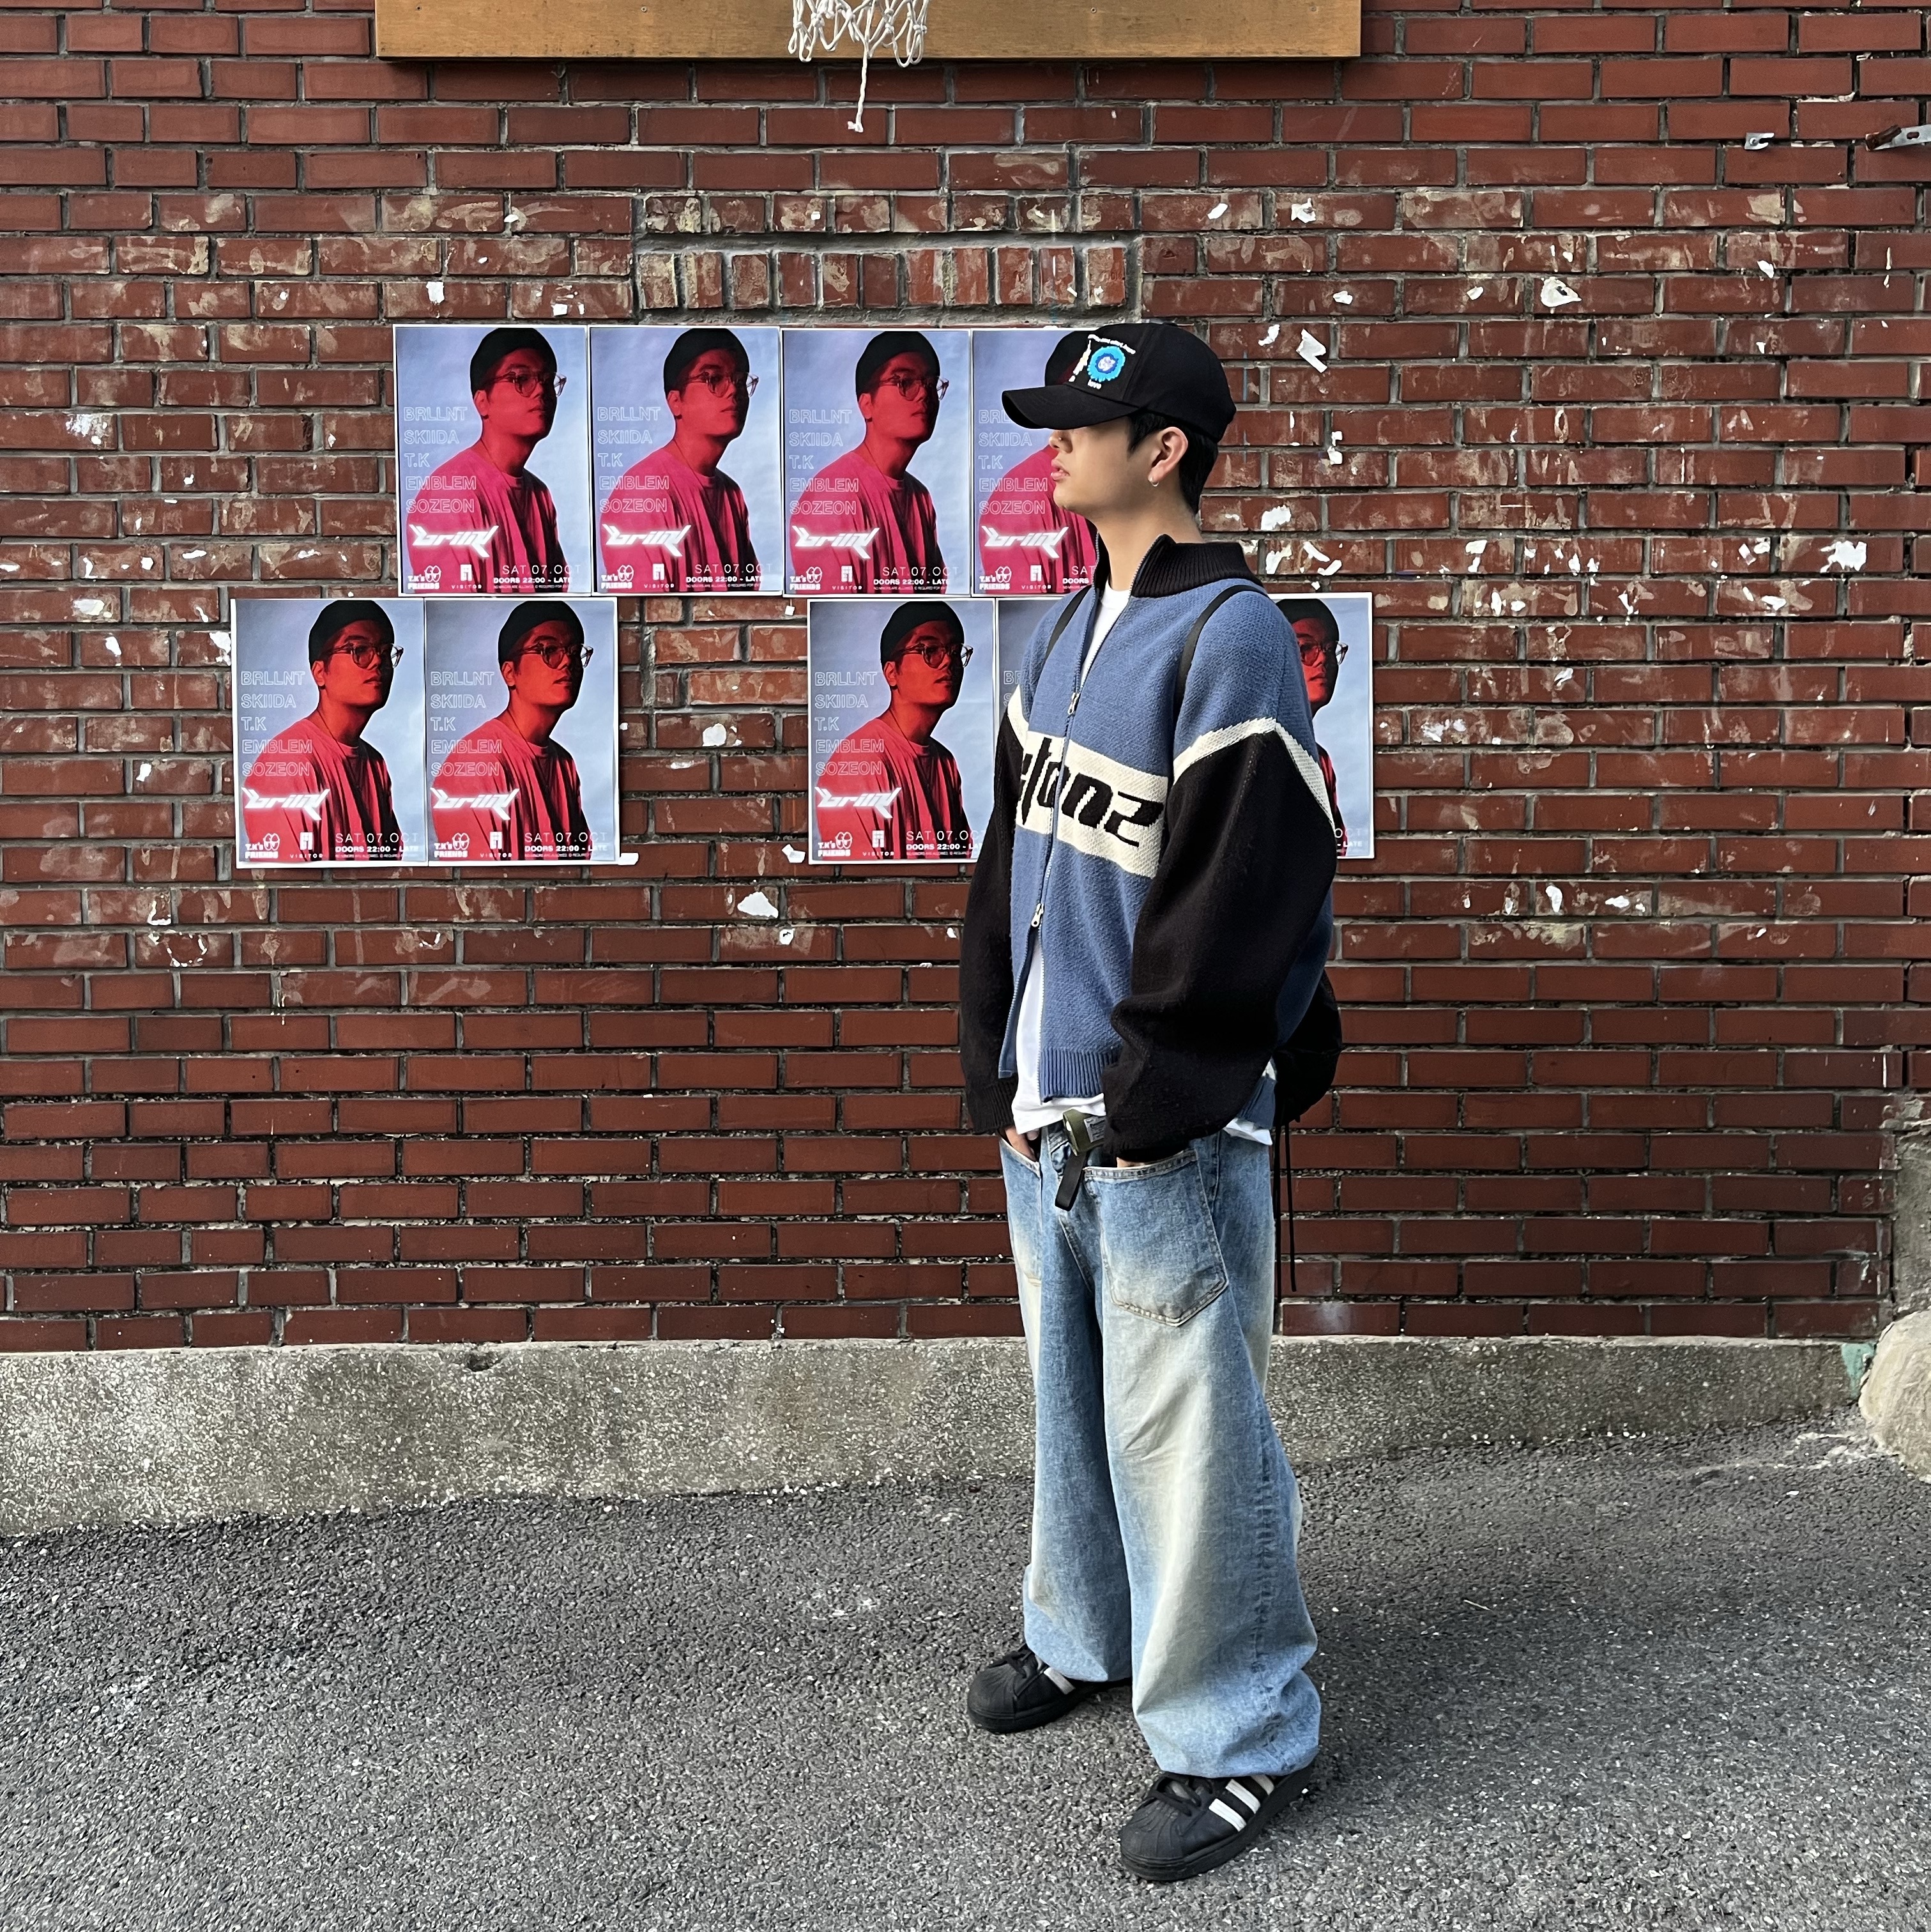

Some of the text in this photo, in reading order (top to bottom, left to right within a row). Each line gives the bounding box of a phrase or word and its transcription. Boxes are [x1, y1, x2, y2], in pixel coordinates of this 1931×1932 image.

[404, 406, 468, 421] BRLLNT
[597, 406, 661, 421] BRLLNT
[789, 409, 852, 424] BRLLNT
[404, 429, 459, 444] SKIIDA
[598, 429, 653, 444] SKIIDA
[789, 432, 843, 447] SKIIDA
[978, 432, 1032, 447] SKIIDA
[404, 453, 430, 467] T.K
[598, 452, 623, 467] T.K
[789, 455, 814, 470] T.K
[978, 455, 1004, 470] T.K
[406, 476, 477, 490] EMBLEM
[599, 475, 669, 490] EMBLEM
[790, 478, 859, 493] EMBLEM
[979, 477, 1048, 492] EMBLEM
[406, 499, 474, 513] SOZEON
[599, 498, 668, 513] SOZEON
[790, 501, 857, 515] SOZEON
[979, 500, 1046, 515] SOZEON
[241, 671, 305, 686] BRLLNT
[431, 671, 494, 686] BRLLNT
[814, 671, 878, 686] BRLLNT
[241, 693, 296, 709] SKIIDA
[431, 694, 486, 709] SKIIDA
[814, 694, 869, 709] SKIIDA
[241, 717, 266, 731] T.K
[431, 717, 456, 732] T.K
[814, 717, 839, 731] T.K
[242, 739, 312, 754] EMBLEM
[431, 739, 502, 754] EMBLEM
[815, 739, 885, 753] EMBLEM
[242, 762, 310, 776] SOZEON
[431, 762, 500, 776] SOZEON
[815, 761, 883, 776] SOZEON
